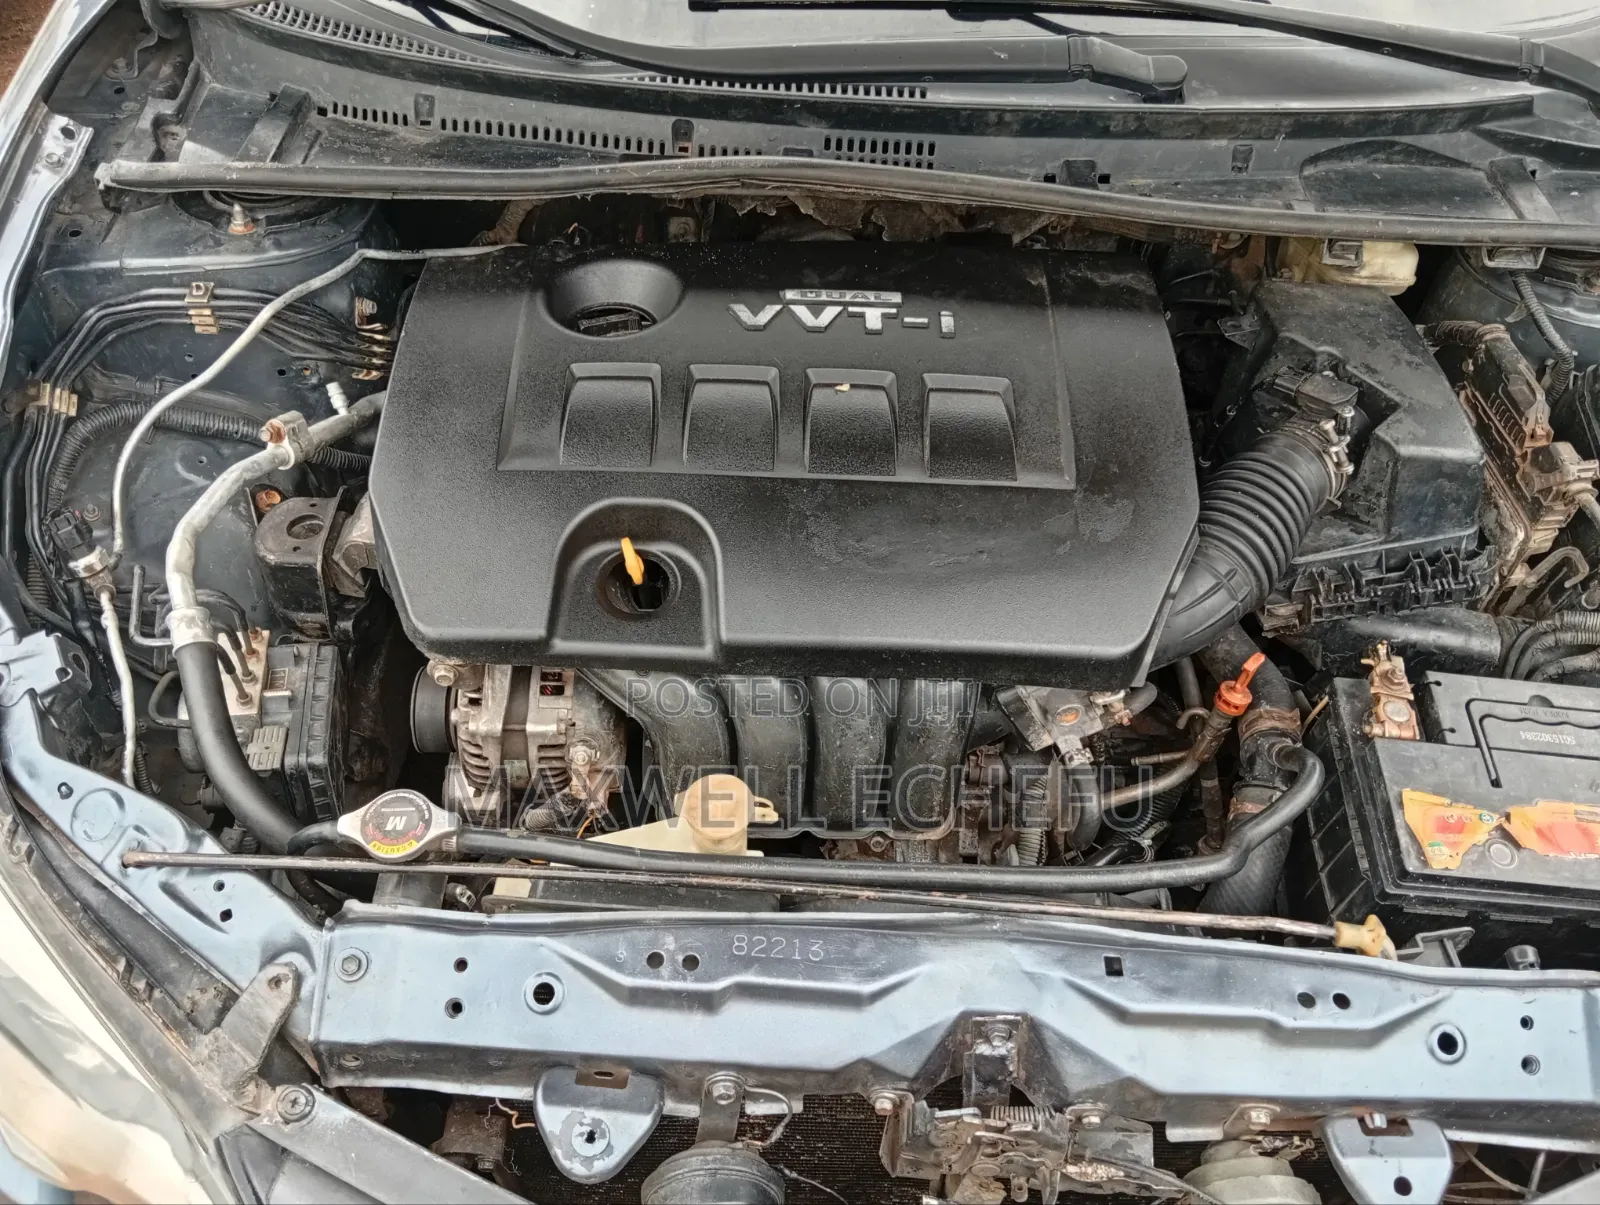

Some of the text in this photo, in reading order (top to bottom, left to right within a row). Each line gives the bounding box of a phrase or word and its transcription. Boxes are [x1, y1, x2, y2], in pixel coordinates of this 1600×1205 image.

[796, 288, 896, 302] DUAL
[728, 303, 956, 339] VVT-i
[732, 934, 824, 961] 82213
